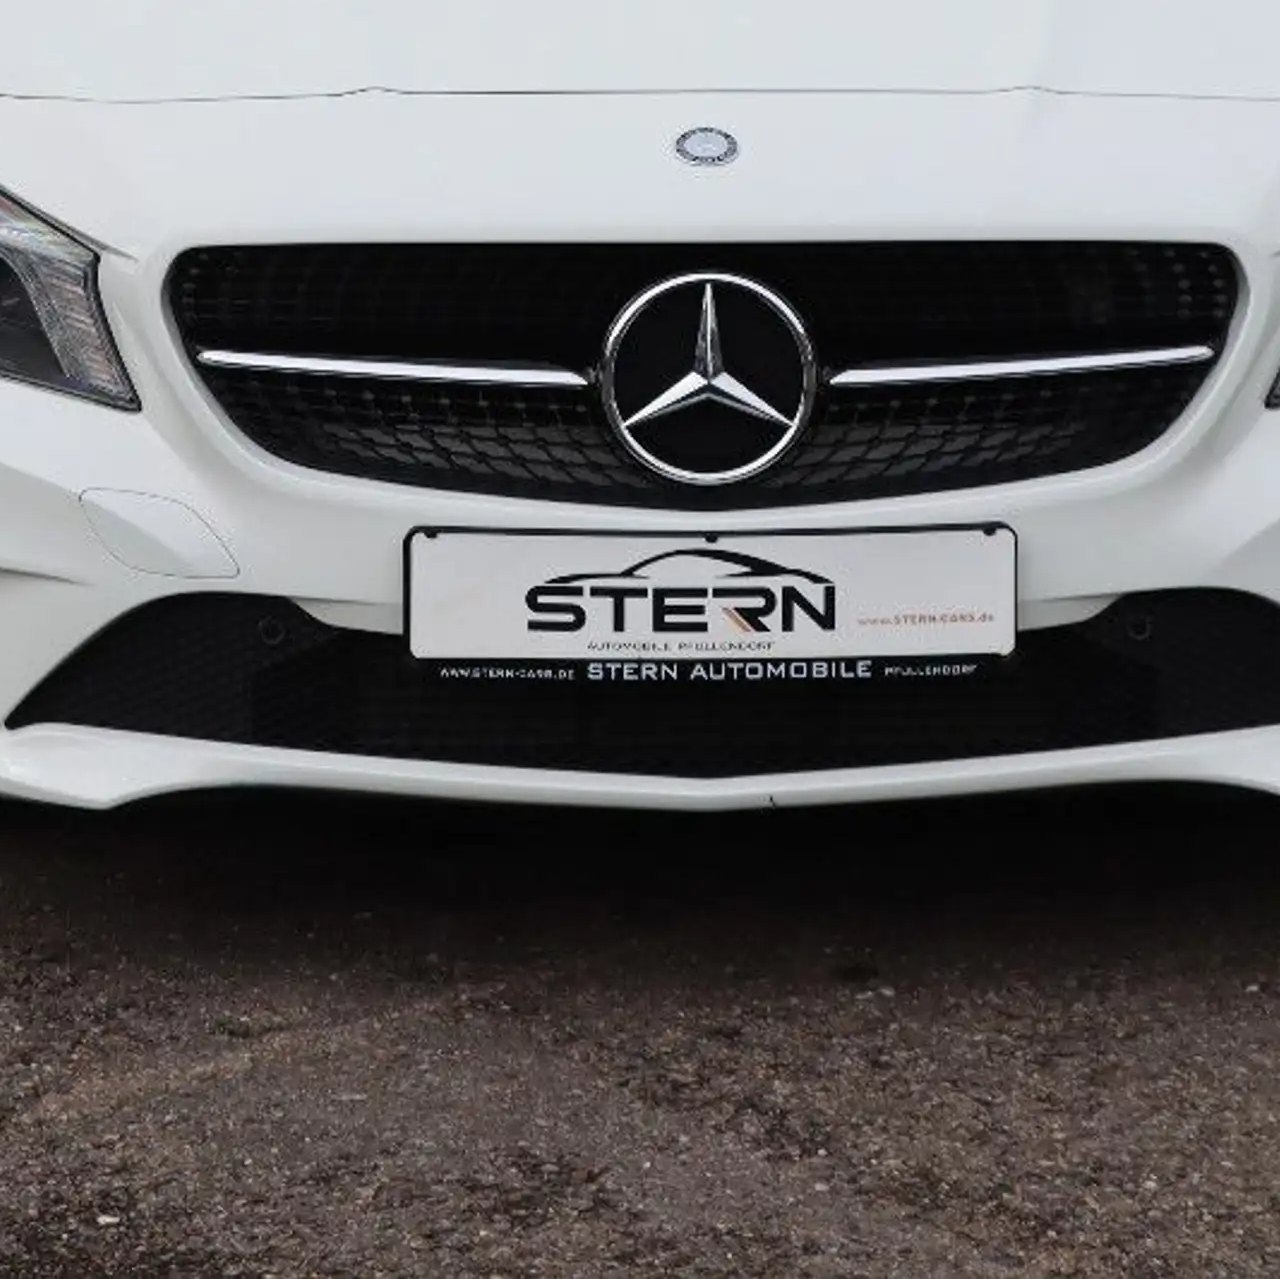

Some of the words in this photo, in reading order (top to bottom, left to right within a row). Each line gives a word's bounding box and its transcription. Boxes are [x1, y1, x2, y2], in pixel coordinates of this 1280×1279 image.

[524, 584, 836, 633] STERN
[586, 661, 679, 682] STERN
[691, 659, 874, 681] AUTOMOBILE
